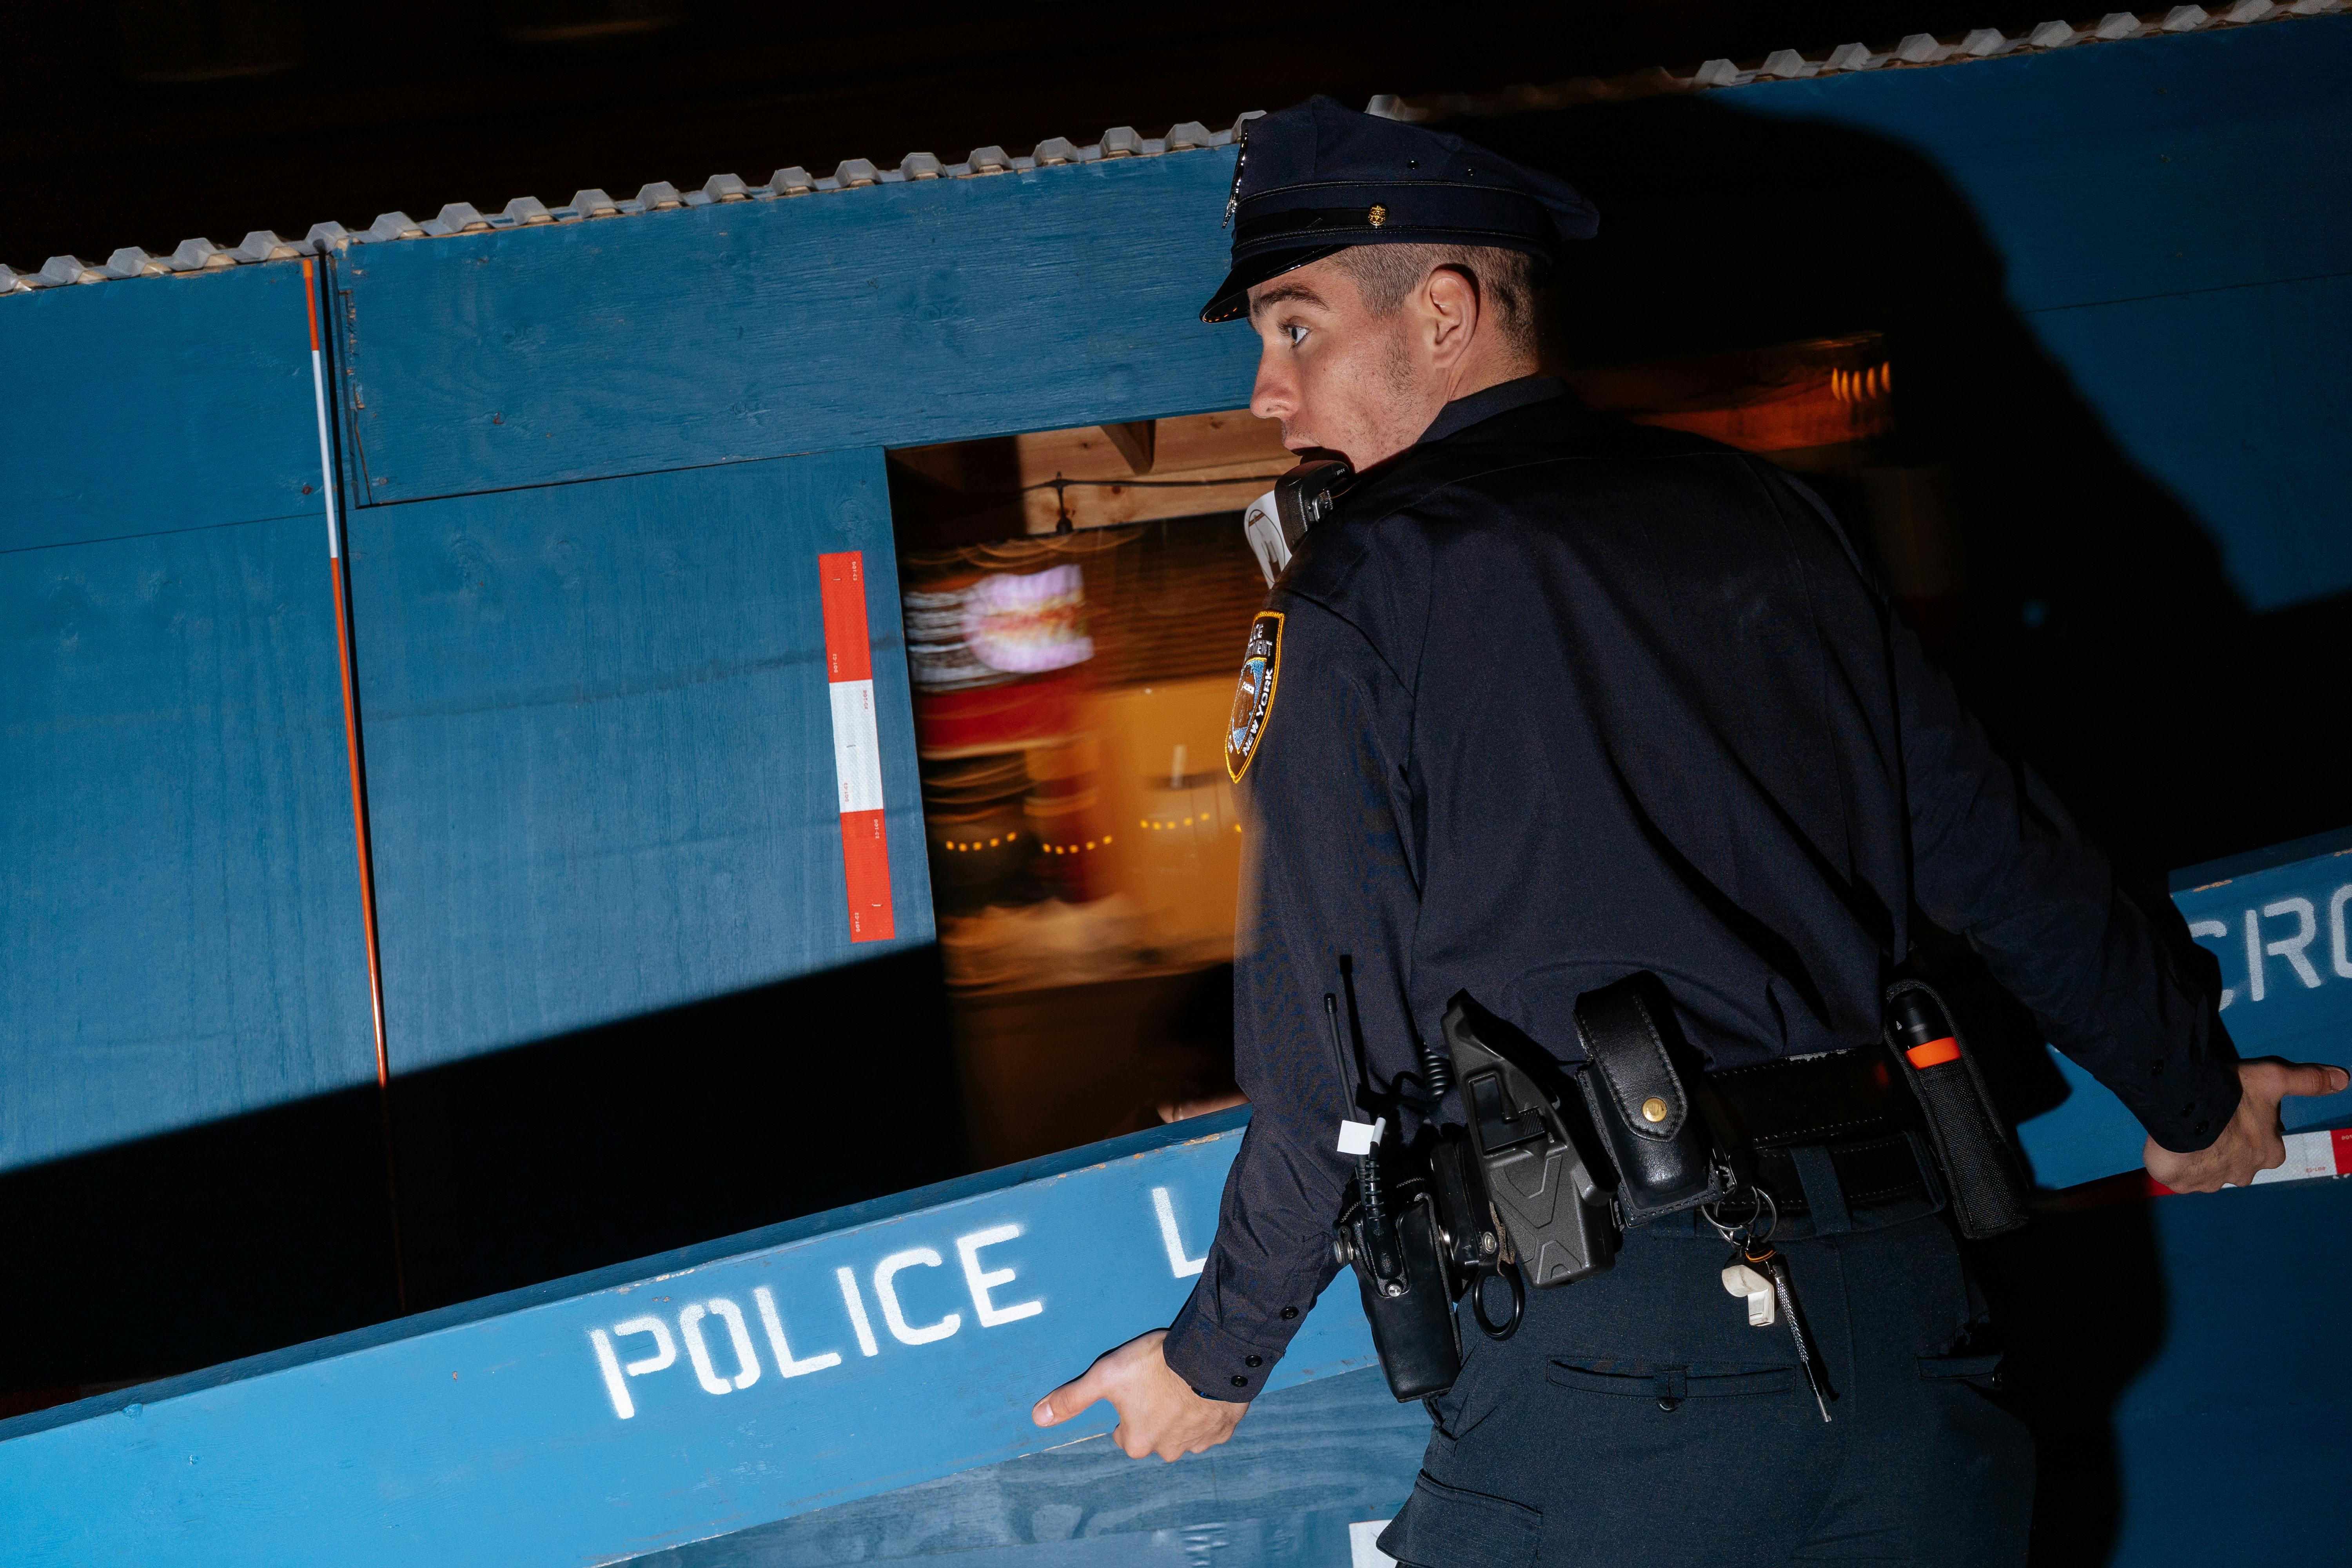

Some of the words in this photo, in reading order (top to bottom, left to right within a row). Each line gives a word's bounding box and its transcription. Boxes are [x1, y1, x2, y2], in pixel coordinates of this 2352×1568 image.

[1242, 719, 1258, 757] NEW
[1256, 668, 1273, 717] YORK
[591, 1224, 1043, 1419] POLICE
[1152, 1187, 1209, 1278] L
